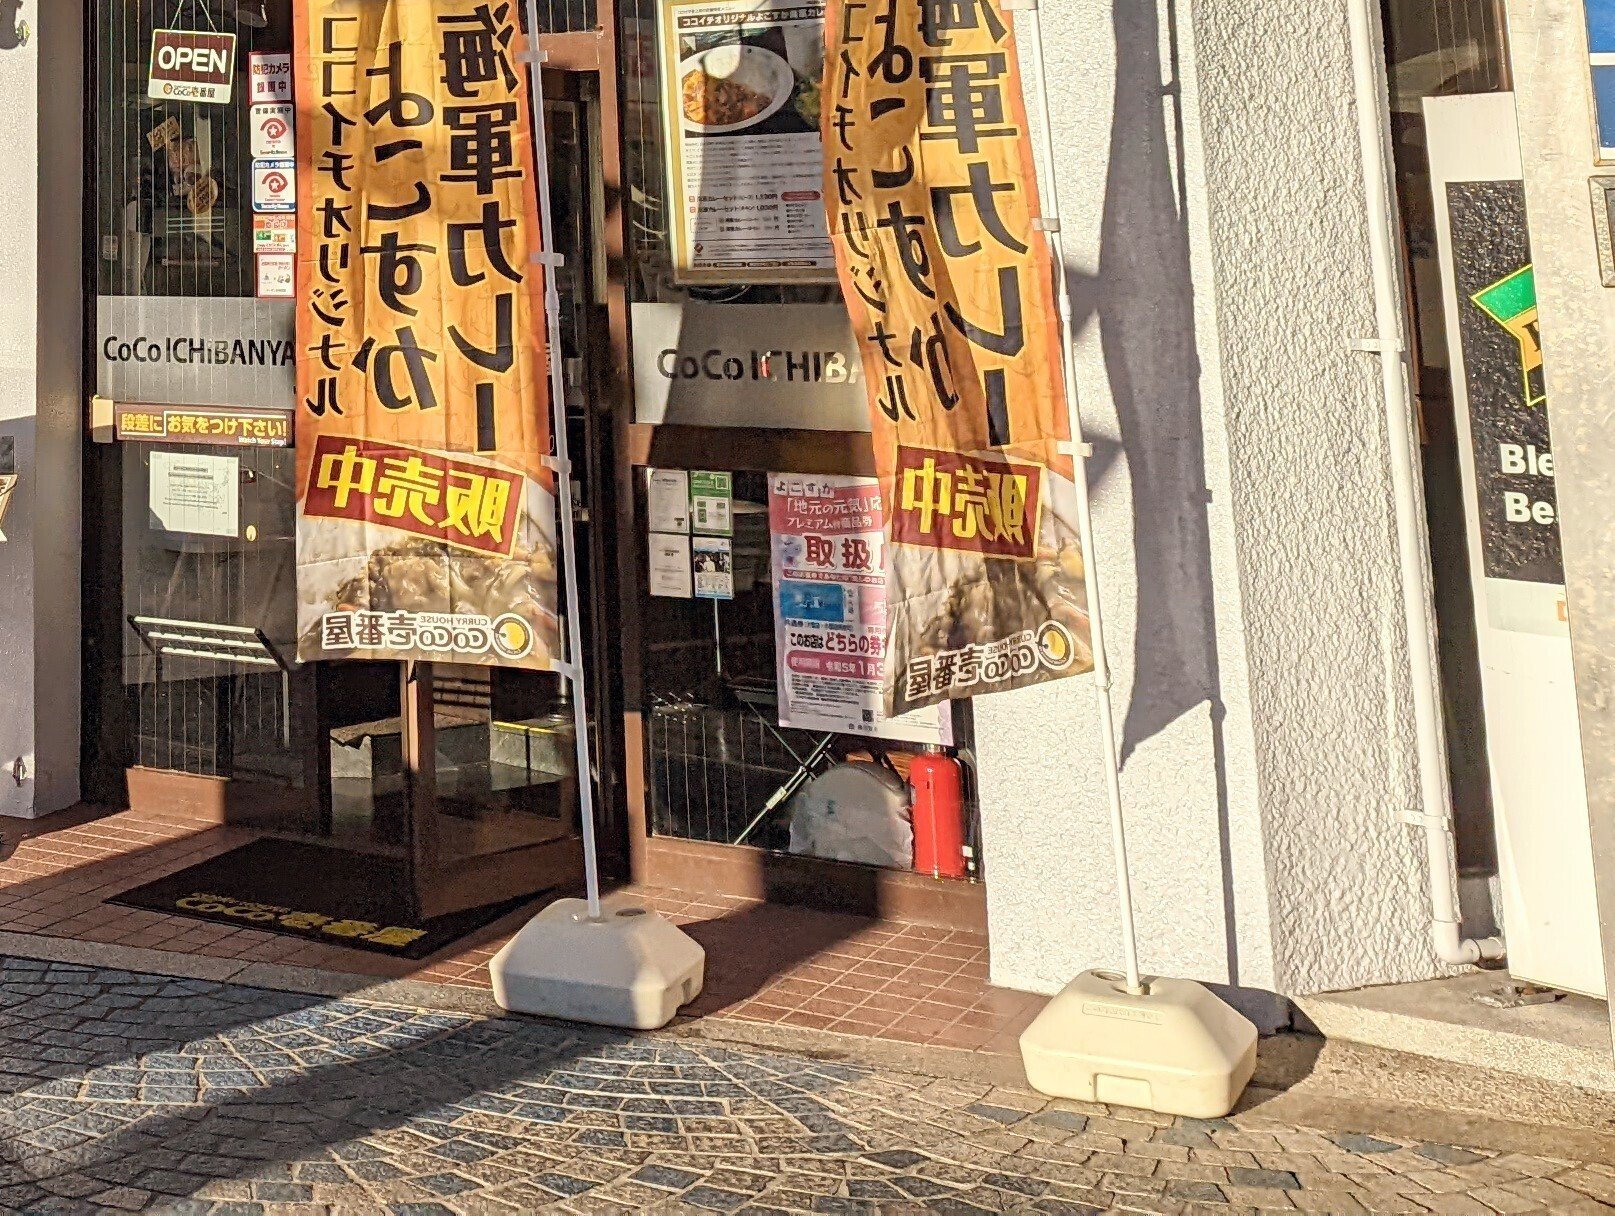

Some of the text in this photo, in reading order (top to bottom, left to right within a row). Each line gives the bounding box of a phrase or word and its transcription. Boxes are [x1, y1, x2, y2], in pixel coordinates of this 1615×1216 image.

[157, 45, 228, 74] OPEN
[252, 62, 290, 76] 防犯カメラ
[121, 411, 287, 437] 段差に お気をつけ下さい!
[775, 480, 832, 495] よこすか
[1503, 490, 1558, 525] Be
